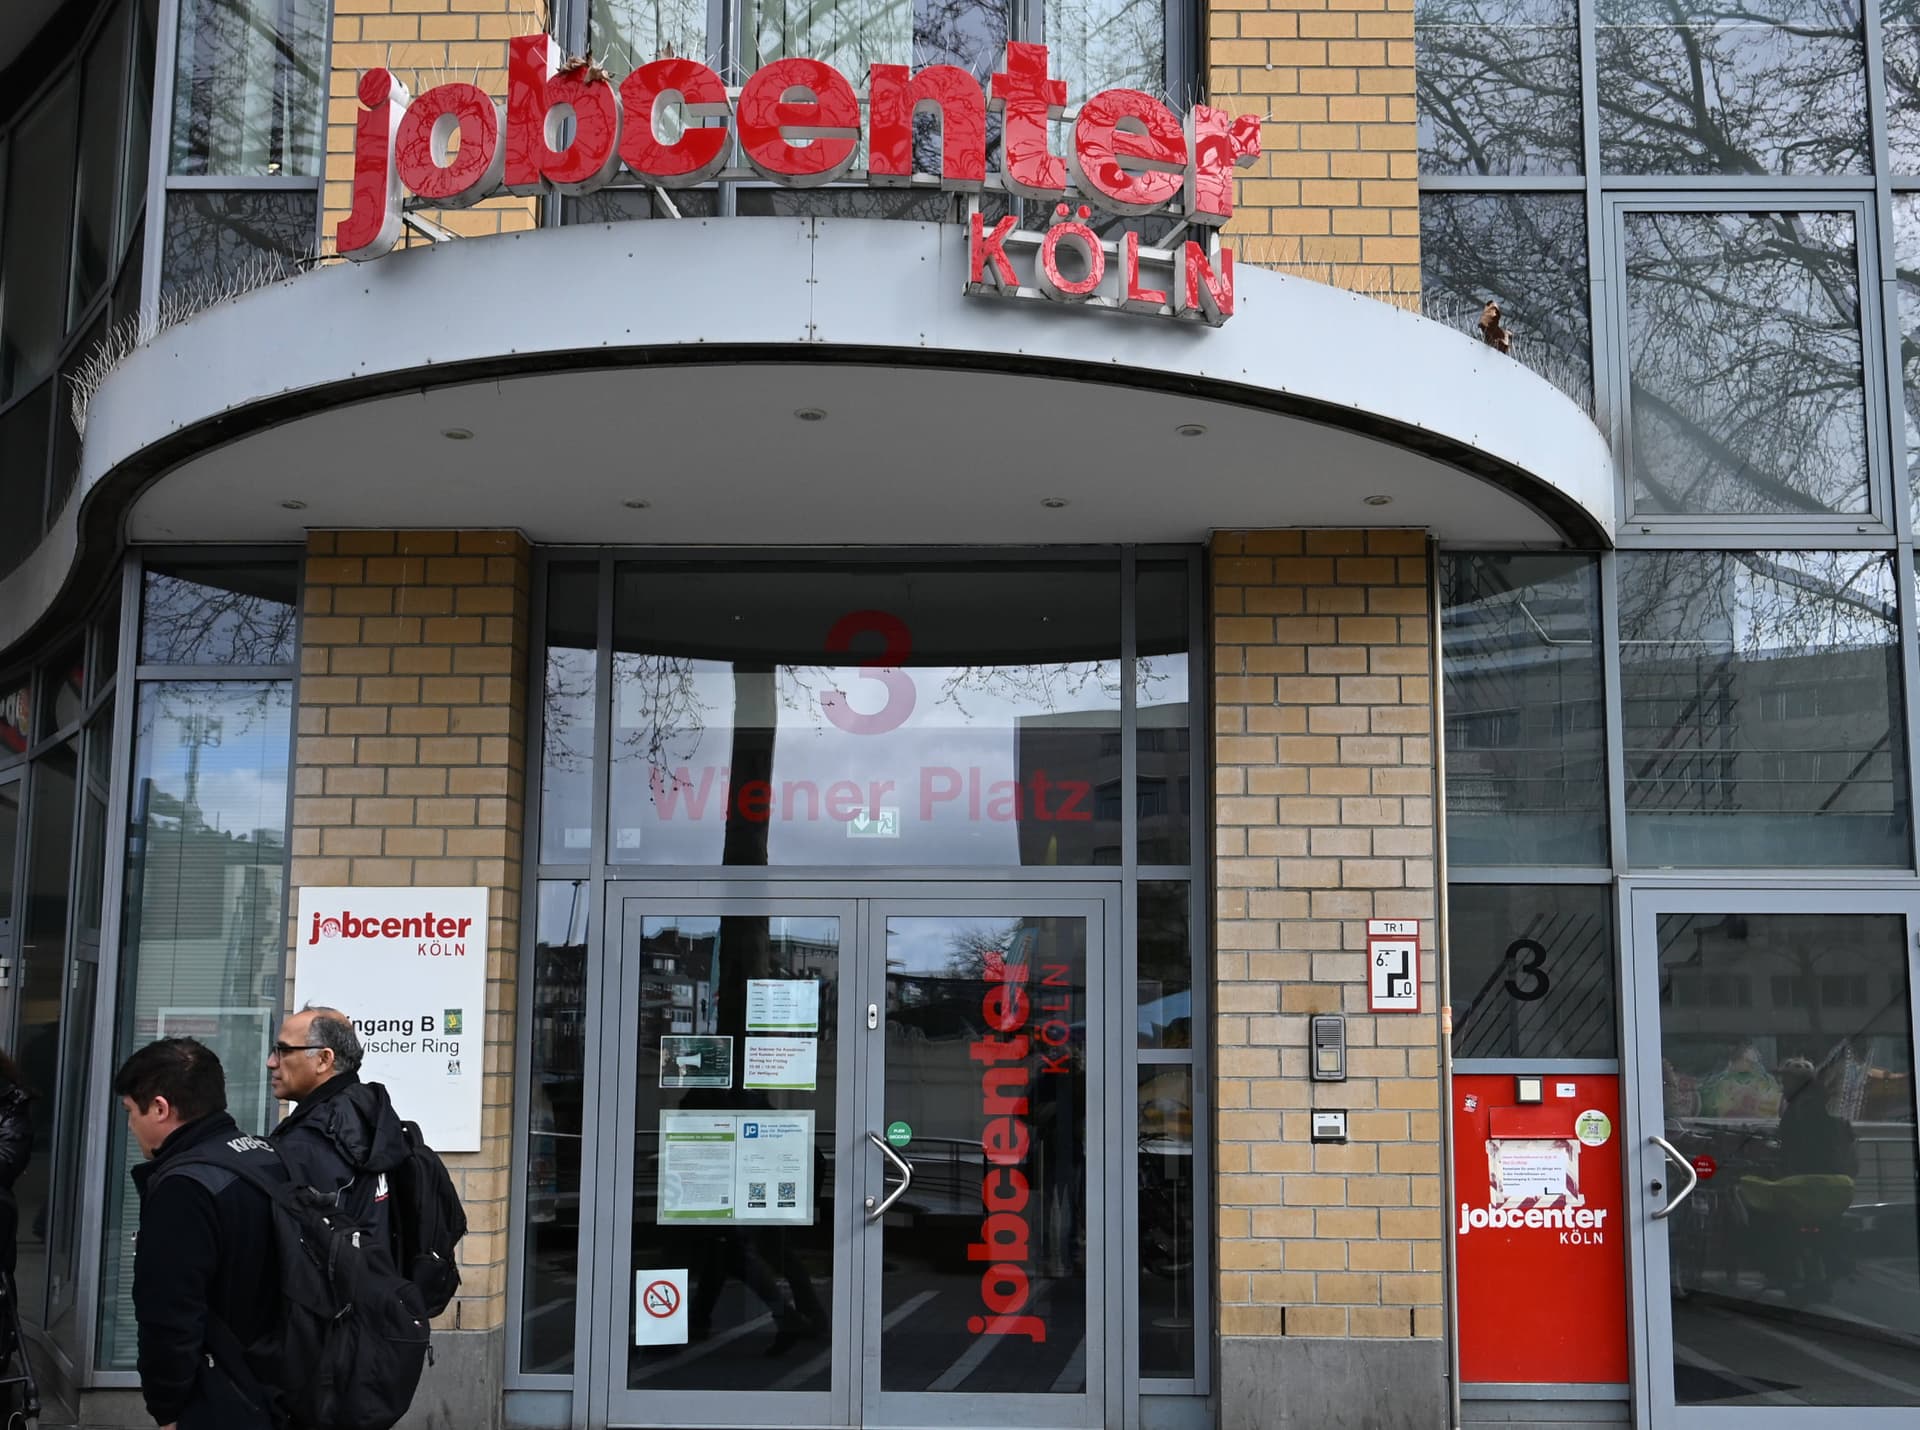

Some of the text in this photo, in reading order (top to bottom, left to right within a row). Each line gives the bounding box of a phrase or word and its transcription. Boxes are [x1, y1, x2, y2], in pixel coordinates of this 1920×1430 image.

[336, 33, 1262, 262] jobcenter
[967, 203, 1235, 326] KÖLN
[819, 609, 917, 735] 3
[648, 766, 1093, 822] Wiener Platz
[308, 911, 472, 945] jobcenter
[418, 940, 465, 956] KÖLN
[1384, 923, 1397, 932] TR
[1504, 938, 1550, 1001] 3
[421, 1015, 435, 1032] B
[1034, 963, 1071, 1074] KÖLN
[422, 1038, 459, 1057] Ring
[967, 952, 1046, 1343] jobcenter
[1459, 1203, 1607, 1234] jobcenter
[1559, 1229, 1603, 1244] KÖLN
